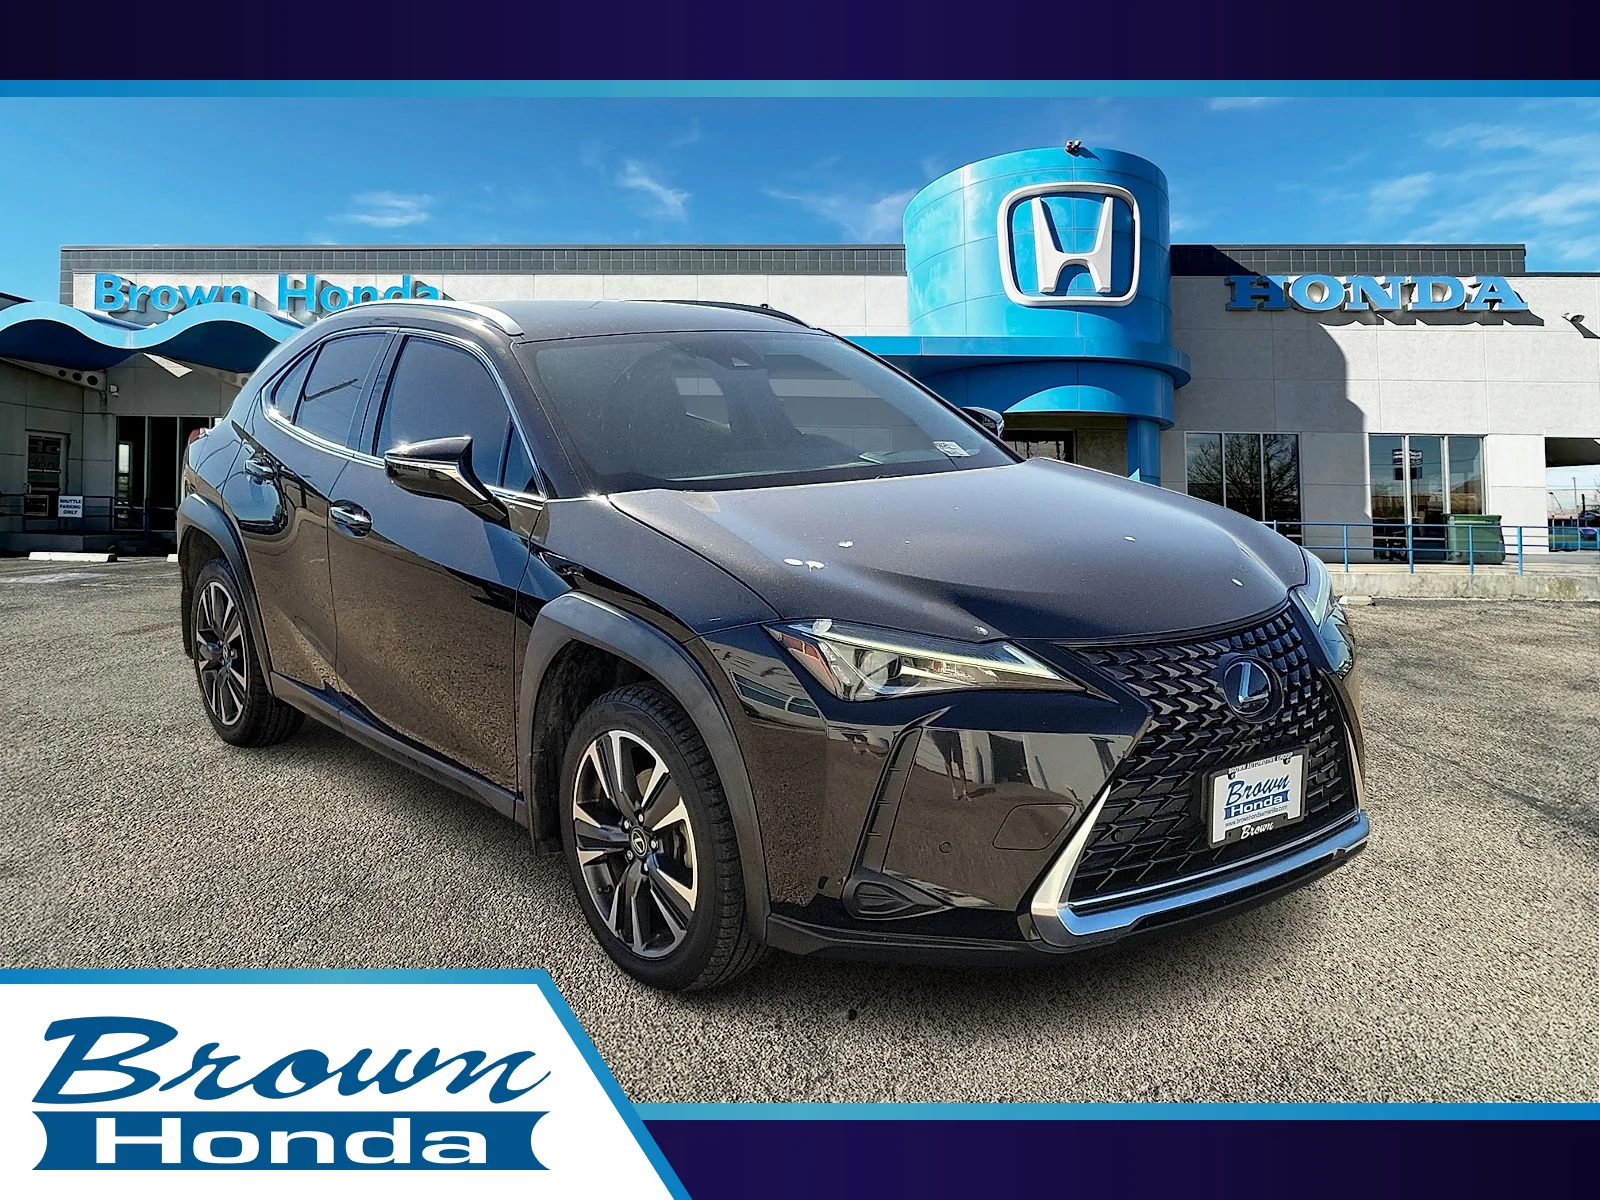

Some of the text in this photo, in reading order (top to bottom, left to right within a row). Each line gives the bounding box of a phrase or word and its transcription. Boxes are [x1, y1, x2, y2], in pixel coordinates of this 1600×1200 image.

[94, 273, 440, 312] Brown Honda
[1226, 274, 1528, 313] HONDA
[1226, 774, 1289, 806] Brown
[1230, 795, 1283, 817] Honda
[1240, 821, 1275, 840] Brown
